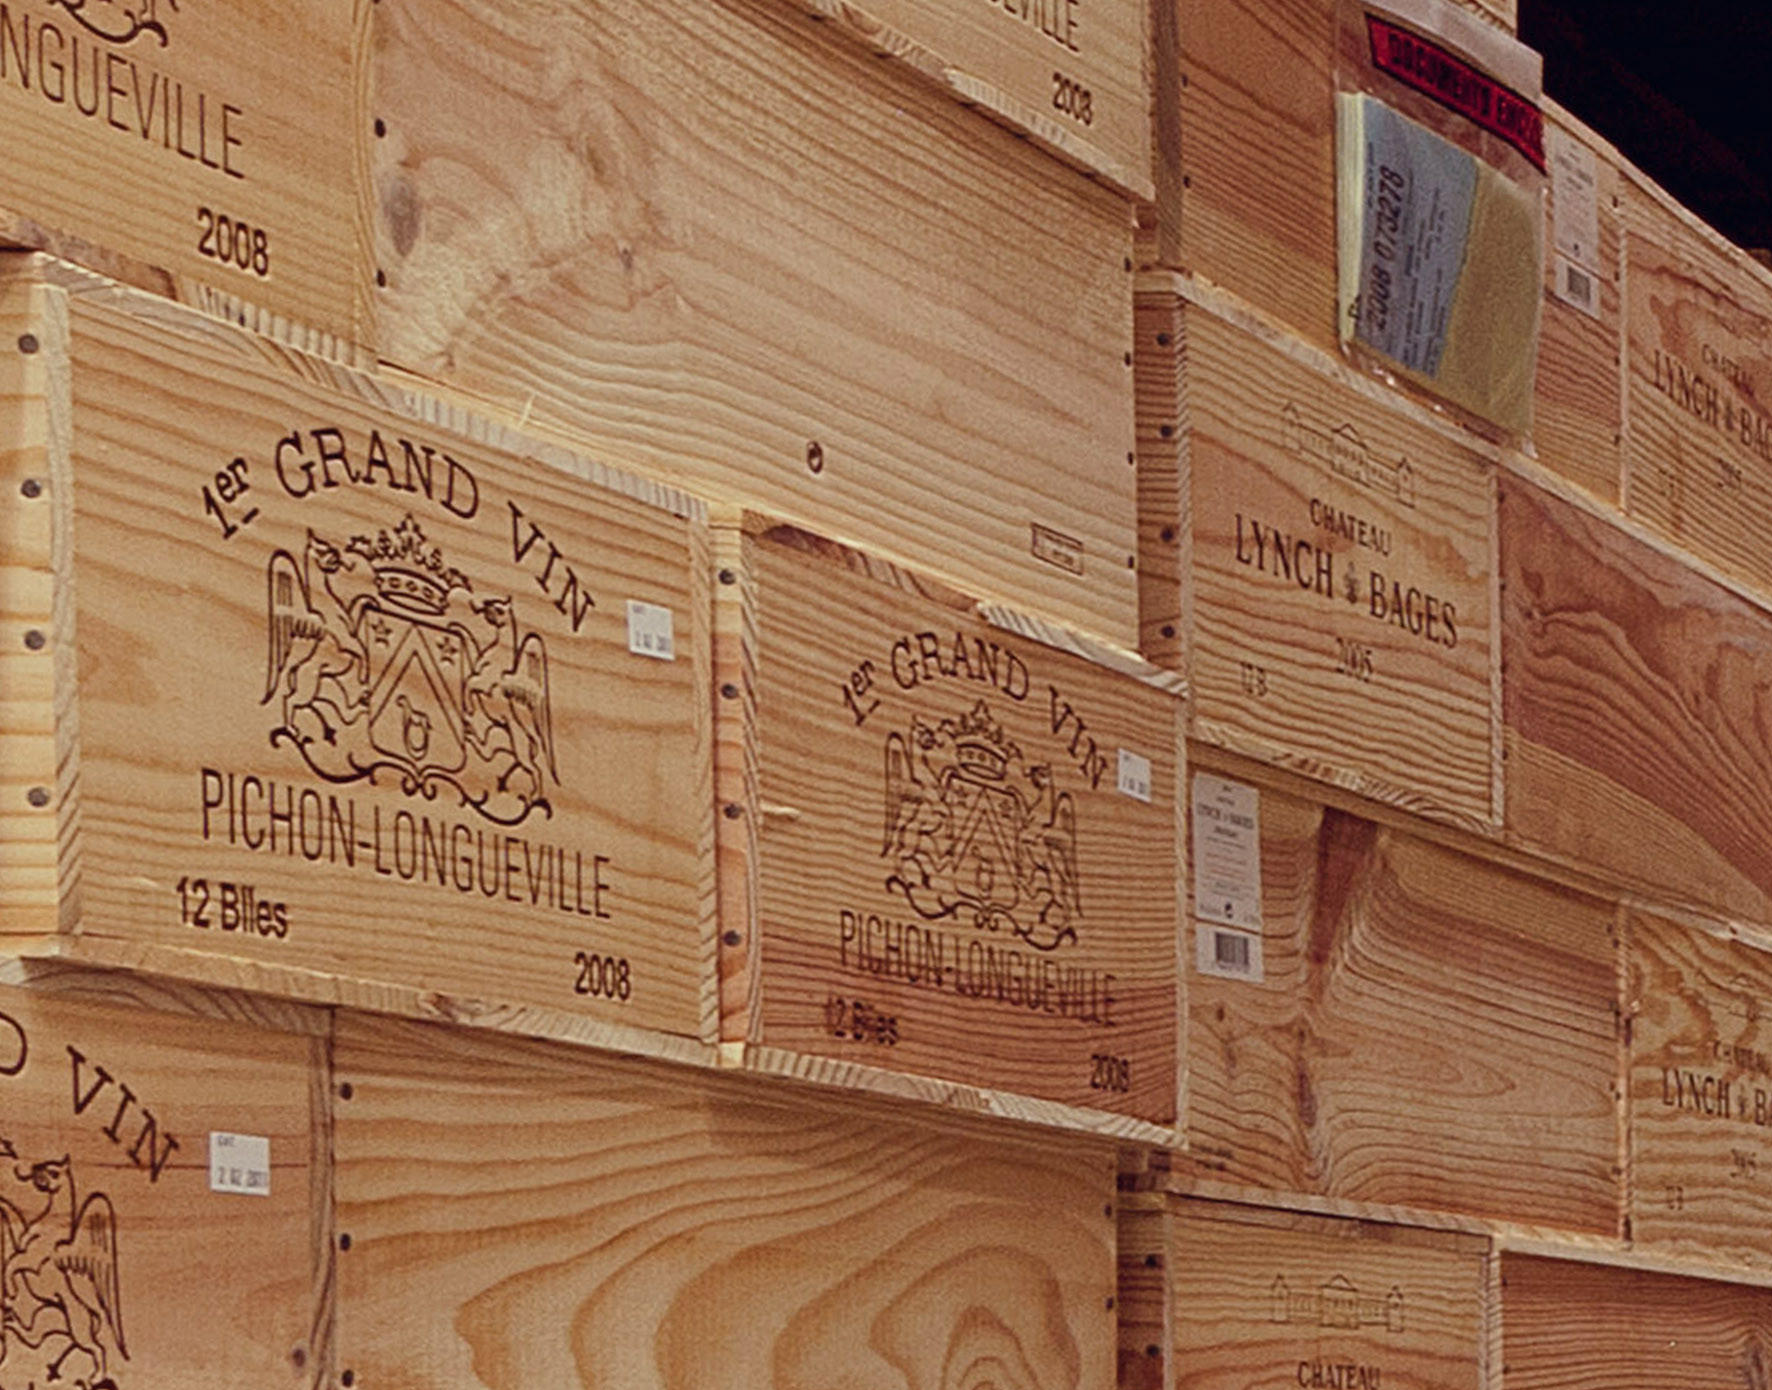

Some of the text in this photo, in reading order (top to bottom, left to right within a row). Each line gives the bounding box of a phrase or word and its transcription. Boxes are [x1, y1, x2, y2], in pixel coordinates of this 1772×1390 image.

[1051, 72, 1095, 127] 2008
[196, 207, 270, 277] 2008
[274, 426, 482, 522] GRAND
[505, 499, 597, 634] VIN
[1308, 498, 1393, 557] CHATEAU
[1235, 513, 1459, 650] LYNCH BAGES
[890, 629, 1030, 702] GRAND
[1047, 688, 1108, 793] VIN
[201, 769, 613, 921] PICHON-LONGUEVILLE
[175, 876, 212, 930] 12
[572, 953, 634, 1003] 2008
[838, 908, 1119, 1031] PICHON-LONGUEVILLE
[1089, 1050, 1132, 1097] 2008
[1662, 1066, 1730, 1119] LYNCH
[65, 1047, 179, 1184] VIN
